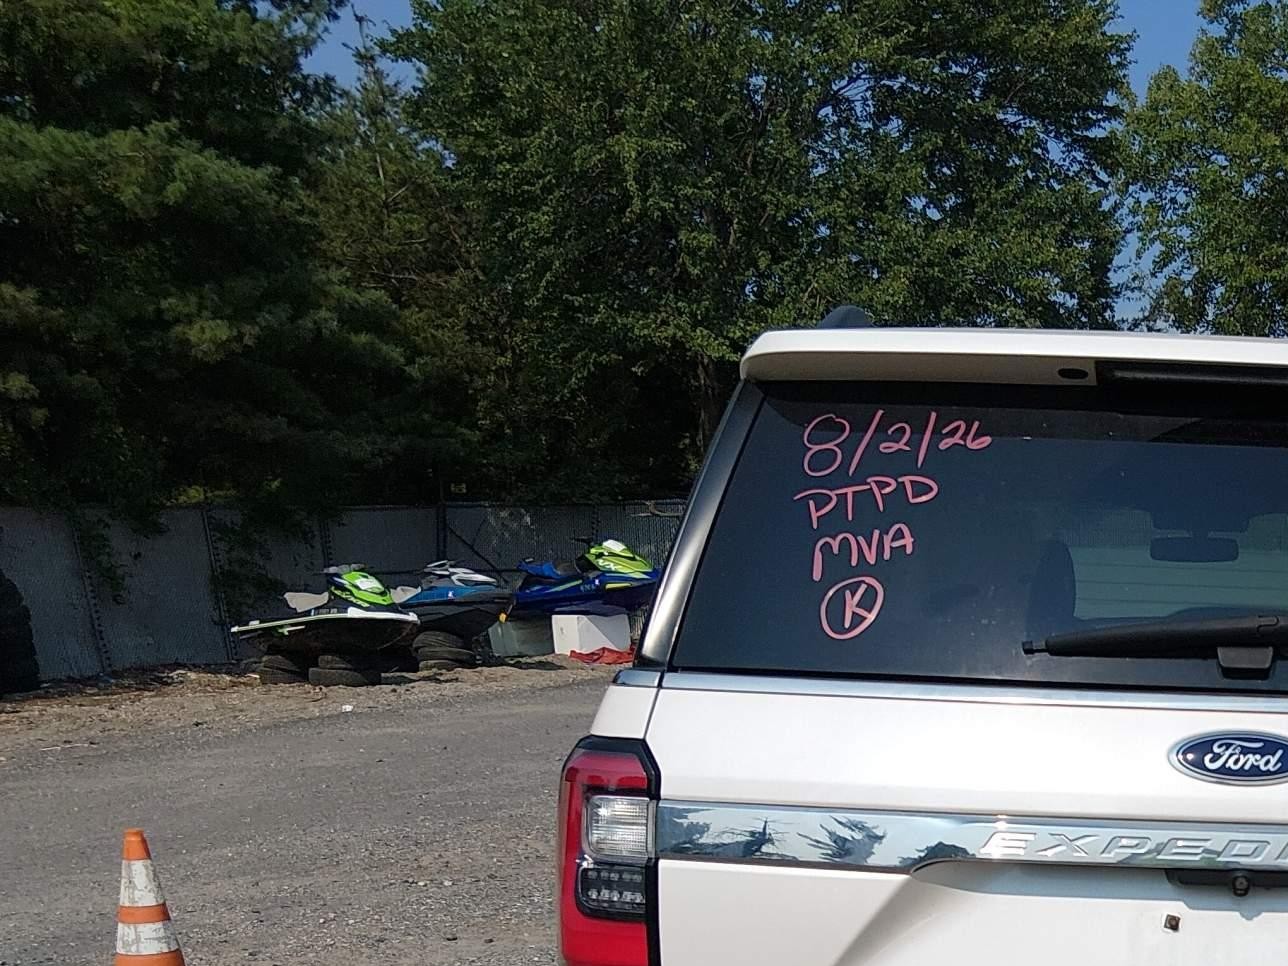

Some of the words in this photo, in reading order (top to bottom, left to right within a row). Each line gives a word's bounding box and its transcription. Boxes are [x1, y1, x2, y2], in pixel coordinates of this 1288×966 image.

[804, 410, 992, 476] 8/2/26
[794, 474, 939, 528] PTPD
[812, 524, 915, 580] MVA
[1204, 739, 1284, 773] Ford
